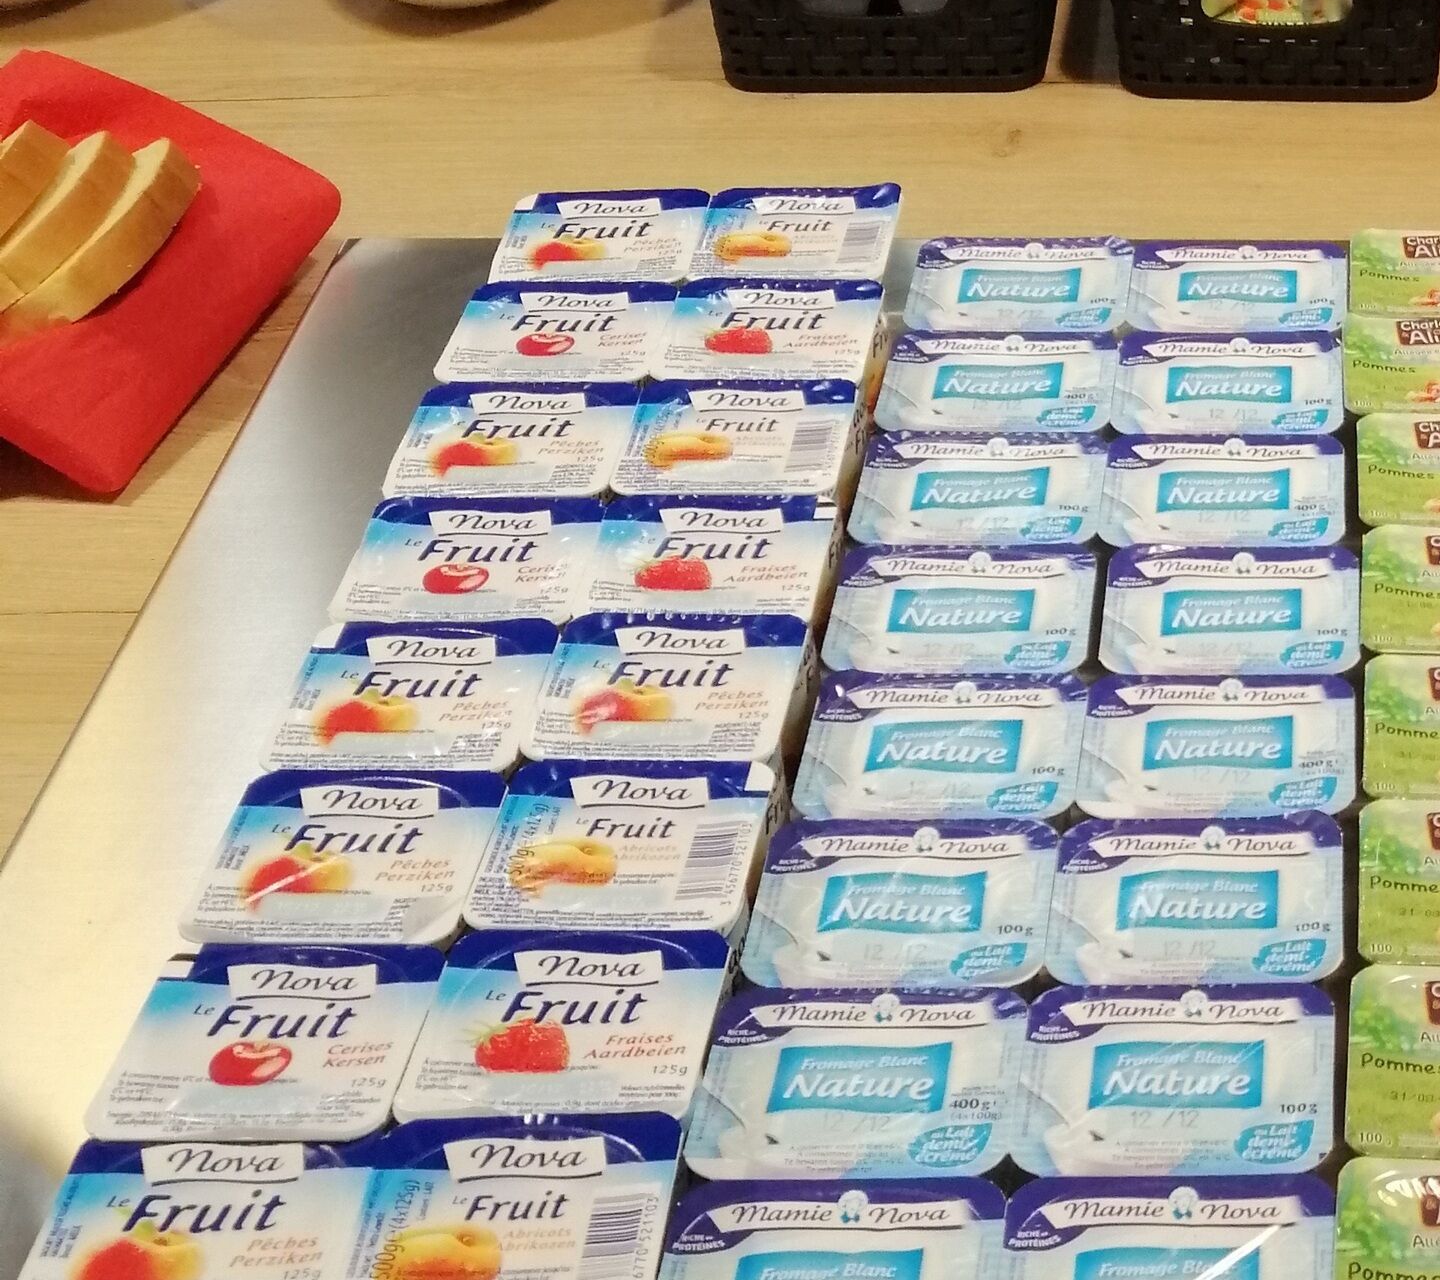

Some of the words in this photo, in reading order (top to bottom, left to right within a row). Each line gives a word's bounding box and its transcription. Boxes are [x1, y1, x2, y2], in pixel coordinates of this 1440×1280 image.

[574, 201, 648, 217] Nova
[769, 197, 845, 214] Nova
[553, 221, 652, 239] Fruit
[766, 220, 832, 236] Fruit
[538, 292, 613, 310] Nova
[743, 291, 821, 308] Nova
[512, 313, 618, 332] Fruit
[720, 311, 826, 331] Fruit
[942, 377, 1052, 395] Nature
[1177, 380, 1282, 398] Nature
[488, 392, 570, 411] Nova
[708, 391, 790, 409] Nova
[462, 419, 575, 439] Fruit
[706, 417, 780, 434] Fruit
[925, 484, 1036, 504] Nature
[1169, 484, 1280, 504] Nature
[448, 512, 538, 531] Nova
[679, 510, 769, 530] Nova
[418, 538, 539, 563] Fruit
[652, 536, 774, 561] Fruit
[992, 562, 1052, 574] Nova
[1256, 563, 1316, 575] Nova
[902, 607, 1023, 626] Nature
[1171, 607, 1293, 626] Nature
[386, 640, 479, 661] Nova
[636, 631, 727, 651] Nova
[353, 670, 482, 699] Fruit
[607, 661, 732, 689] Fruit
[979, 690, 1043, 702] Nova
[1244, 687, 1309, 700] Nova
[876, 742, 1008, 763] Nature
[1155, 739, 1282, 760] Nature
[593, 779, 691, 802] Nova
[324, 789, 422, 812] Nova
[587, 818, 674, 839] Fruit
[287, 823, 423, 854] Fruit
[939, 839, 1009, 853] Nova
[1227, 837, 1296, 851] Nova
[389, 859, 449, 870] Pêches
[375, 869, 454, 881] Perziken
[831, 898, 972, 923] Nature
[1131, 895, 1265, 919] Nature
[537, 954, 644, 979] Nova
[251, 967, 354, 992] Nova
[503, 988, 648, 1027] Fruit
[901, 1007, 974, 1022] Nova
[1210, 1004, 1283, 1018] Nova
[207, 1005, 358, 1039] Fruit
[607, 1033, 674, 1045] Fraises
[328, 1042, 392, 1056] Cerises
[583, 1045, 686, 1058] Aardbeien
[322, 1054, 385, 1066] Kersen
[802, 1056, 872, 1071] Fromage
[878, 1055, 927, 1068] Blanc
[784, 1072, 933, 1098] Nature
[1104, 1071, 1250, 1096] Nature
[167, 1148, 283, 1175] Nova
[471, 1147, 586, 1172] Nova
[121, 1193, 287, 1233] Fruit
[465, 1193, 569, 1220] Fruit
[869, 1206, 950, 1222] Nova
[1203, 1203, 1280, 1220] Nova
[246, 1237, 317, 1252] Pêches
[229, 1250, 323, 1266] Perziken
[843, 1264, 895, 1279] Blanc
